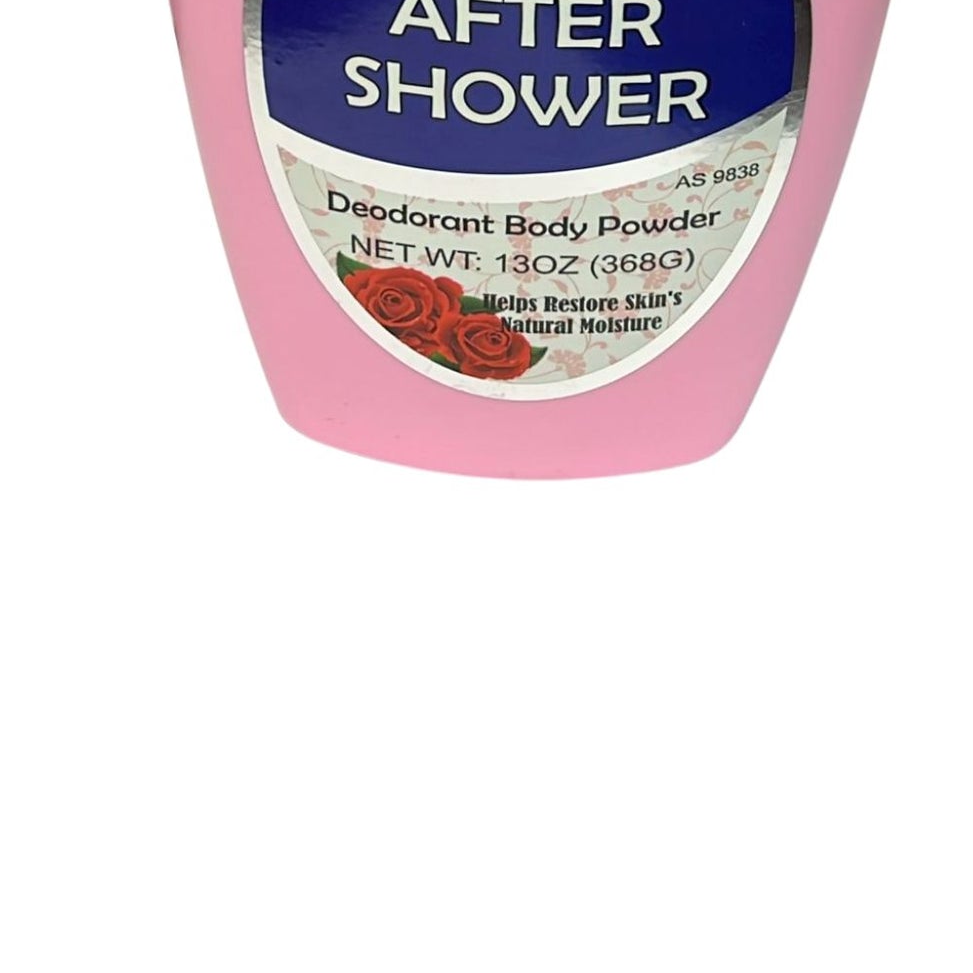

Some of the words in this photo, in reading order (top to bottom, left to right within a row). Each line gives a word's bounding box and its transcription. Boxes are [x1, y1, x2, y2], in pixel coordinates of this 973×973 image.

[344, 55, 710, 128] SHOWER
[674, 173, 707, 191] AS
[712, 163, 760, 185] 9838
[327, 190, 495, 235] Deodorant
[505, 215, 588, 241] Body
[598, 209, 721, 237] Powder
[350, 234, 416, 263] NET
[424, 247, 481, 271] WT:
[494, 253, 580, 275] 13OZ
[589, 248, 696, 279] (368G)
[483, 293, 538, 315] Helps
[544, 292, 620, 313] Restore
[624, 290, 682, 310] Skin's
[499, 317, 573, 335] Natural
[579, 315, 662, 335] Moisture
